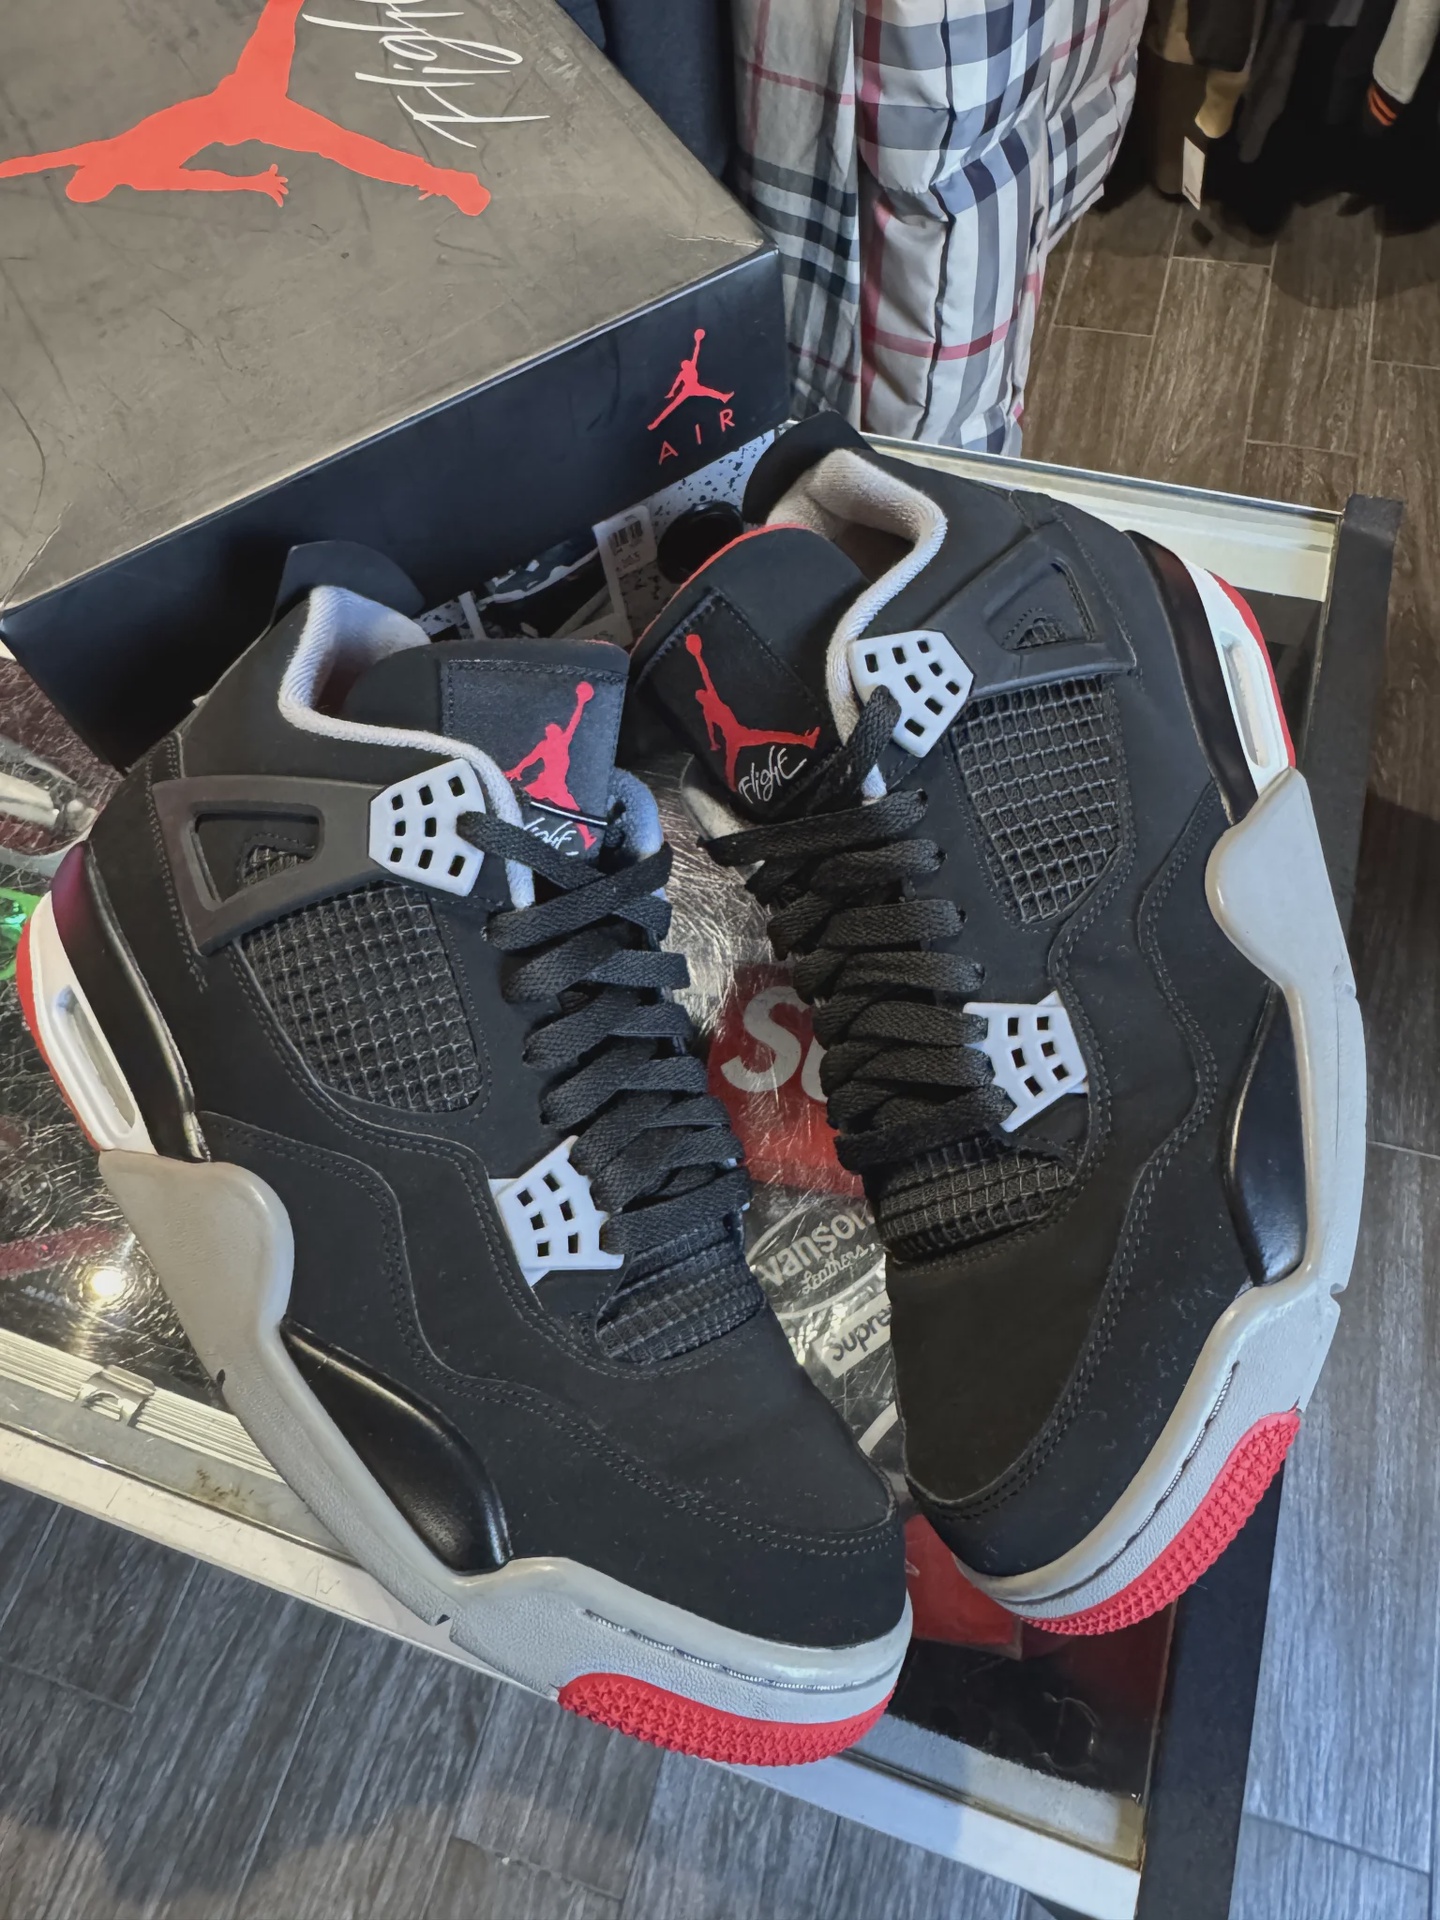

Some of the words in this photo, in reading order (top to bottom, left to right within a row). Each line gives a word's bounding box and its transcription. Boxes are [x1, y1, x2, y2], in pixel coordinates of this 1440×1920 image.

[302, 0, 550, 148] Fligh
[659, 409, 735, 465] AIR
[801, 1244, 869, 1294] Leathers
